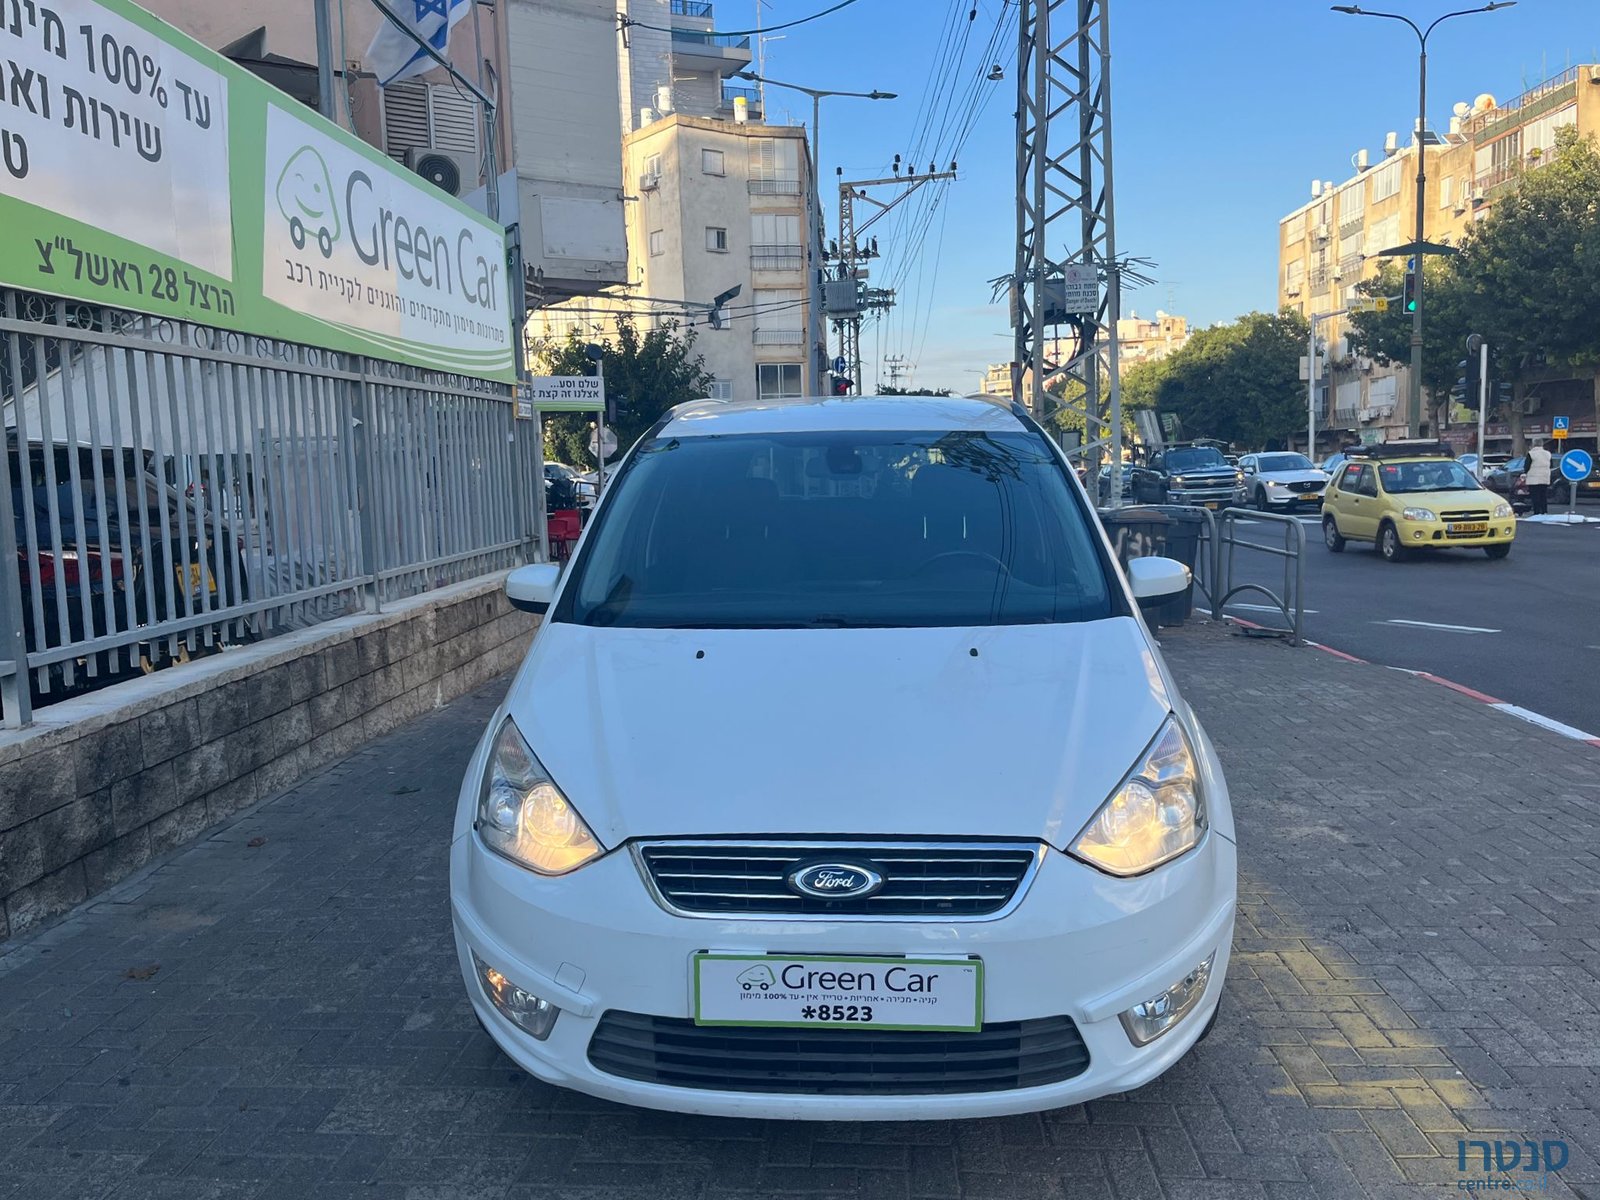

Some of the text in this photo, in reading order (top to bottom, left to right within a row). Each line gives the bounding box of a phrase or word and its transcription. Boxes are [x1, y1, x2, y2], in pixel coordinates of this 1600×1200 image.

[79, 25, 168, 109] 100%
[0, 58, 162, 163] שירות וא
[175, 78, 211, 130] עד
[346, 169, 498, 311] Green Car
[149, 263, 179, 302] 28
[184, 271, 235, 316] הרצל
[285, 259, 504, 343] פתרונות מימון מתקדמים והוגנים לקניית רכב
[578, 379, 599, 388] שלם
[538, 390, 558, 399] קצת
[574, 389, 599, 398] אצלנו
[814, 871, 855, 888] Ford
[781, 964, 938, 992] Green Car
[740, 993, 761, 1001] מימון
[789, 993, 799, 1001] עד
[806, 993, 819, 1002] אין
[850, 994, 879, 1002] אחריות
[918, 996, 938, 1005] קניה
